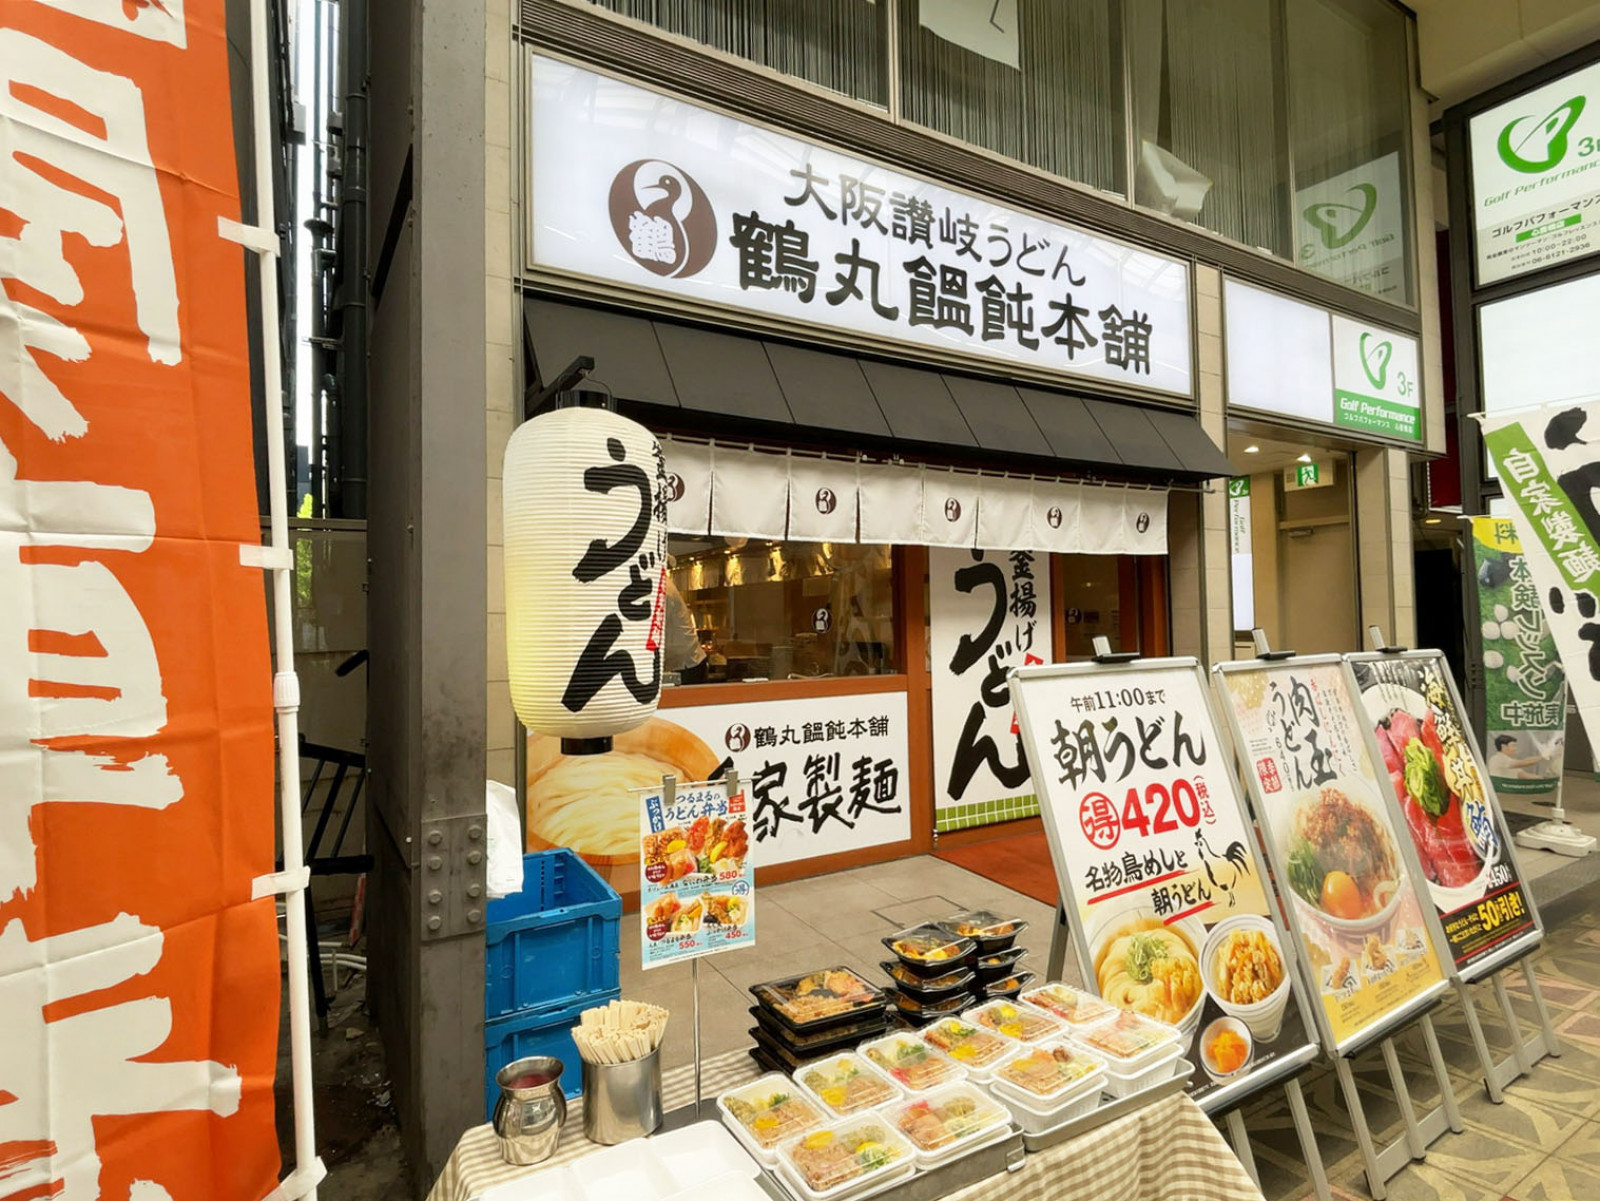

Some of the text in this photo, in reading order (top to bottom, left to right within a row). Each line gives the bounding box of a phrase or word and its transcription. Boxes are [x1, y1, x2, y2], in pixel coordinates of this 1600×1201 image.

[1484, 159, 1600, 207] Golf Performanc
[784, 163, 1086, 286] 大阪讃岐うどん
[729, 210, 1153, 376] 鶴丸饂飩本舗
[1397, 371, 1413, 397] 3F
[1340, 397, 1415, 424] Golf Performance
[562, 437, 661, 713] うどん
[1010, 550, 1037, 653] 釜揚げ
[948, 549, 1031, 801] うどん
[1070, 687, 1166, 713] 午前11:00まで
[754, 714, 889, 749] 鶴丸饂飩本舗
[1050, 710, 1206, 791] 朝うどん
[1269, 681, 1313, 791] うどん
[648, 798, 662, 833] ぶっかけ
[665, 800, 728, 821] うどん弁当
[676, 790, 720, 804] つるまるの
[706, 752, 901, 842] 家製麺
[1122, 778, 1201, 837] 420
[1193, 775, 1217, 825] (税込)
[719, 870, 738, 880] 580
[1085, 848, 1188, 892] 名物鳥めしと
[1151, 878, 1211, 916] 朝うどん
[678, 939, 696, 949] 550
[725, 930, 742, 939] 450
